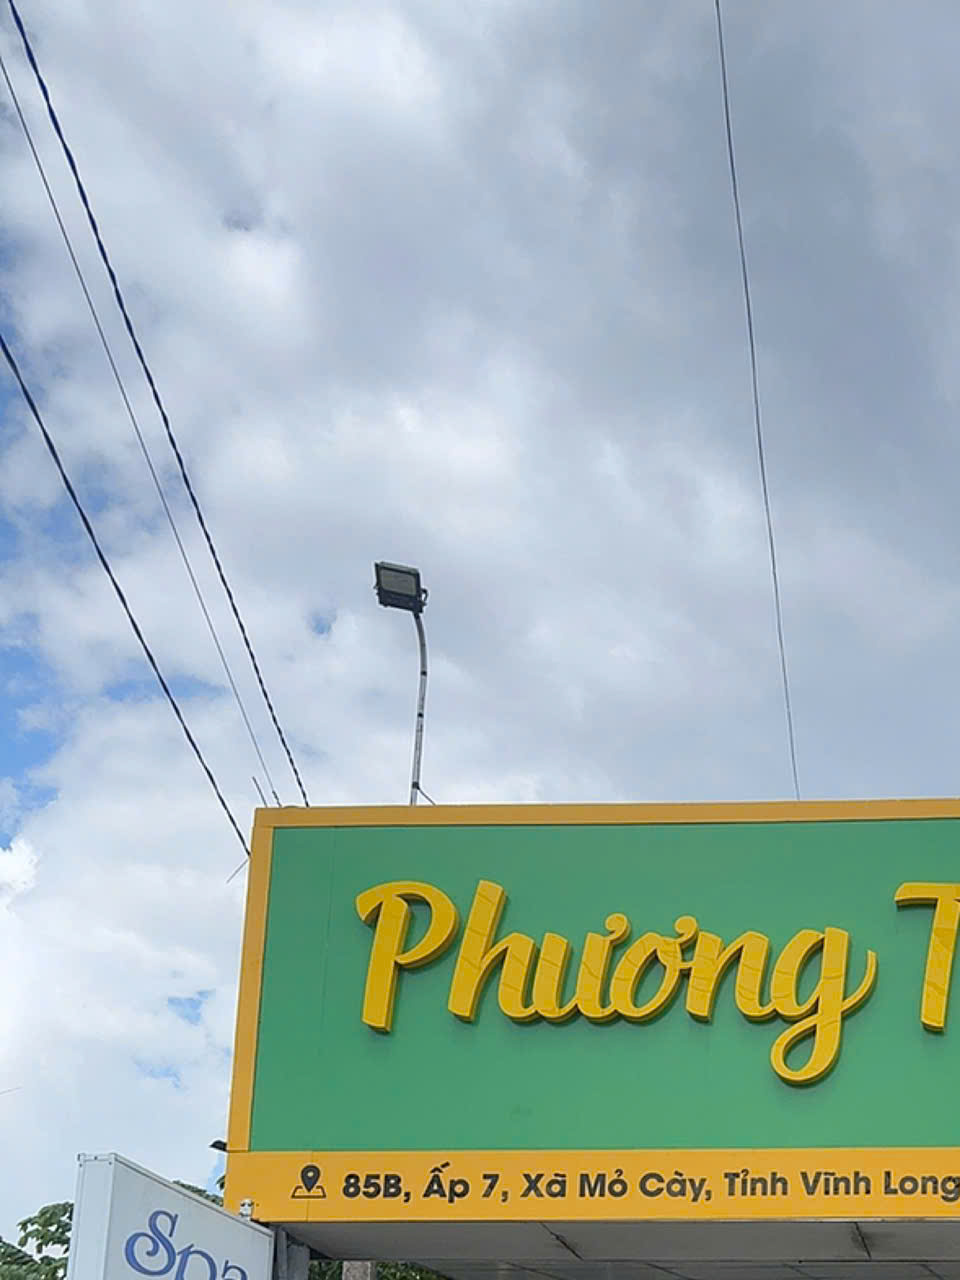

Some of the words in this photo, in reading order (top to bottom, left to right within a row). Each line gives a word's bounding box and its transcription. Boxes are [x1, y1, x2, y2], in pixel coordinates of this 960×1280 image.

[355, 878, 877, 1087] Phương
[341, 1171, 411, 1202] 85B,
[422, 1162, 470, 1205] Ấp
[481, 1171, 509, 1203] 7,
[519, 1172, 568, 1197] Xã
[578, 1166, 628, 1197] Mỏ
[638, 1169, 712, 1203] Cày,
[723, 1167, 788, 1196] Tỉnh
[800, 1168, 871, 1195] Vĩnh
[883, 1171, 960, 1202] Long
